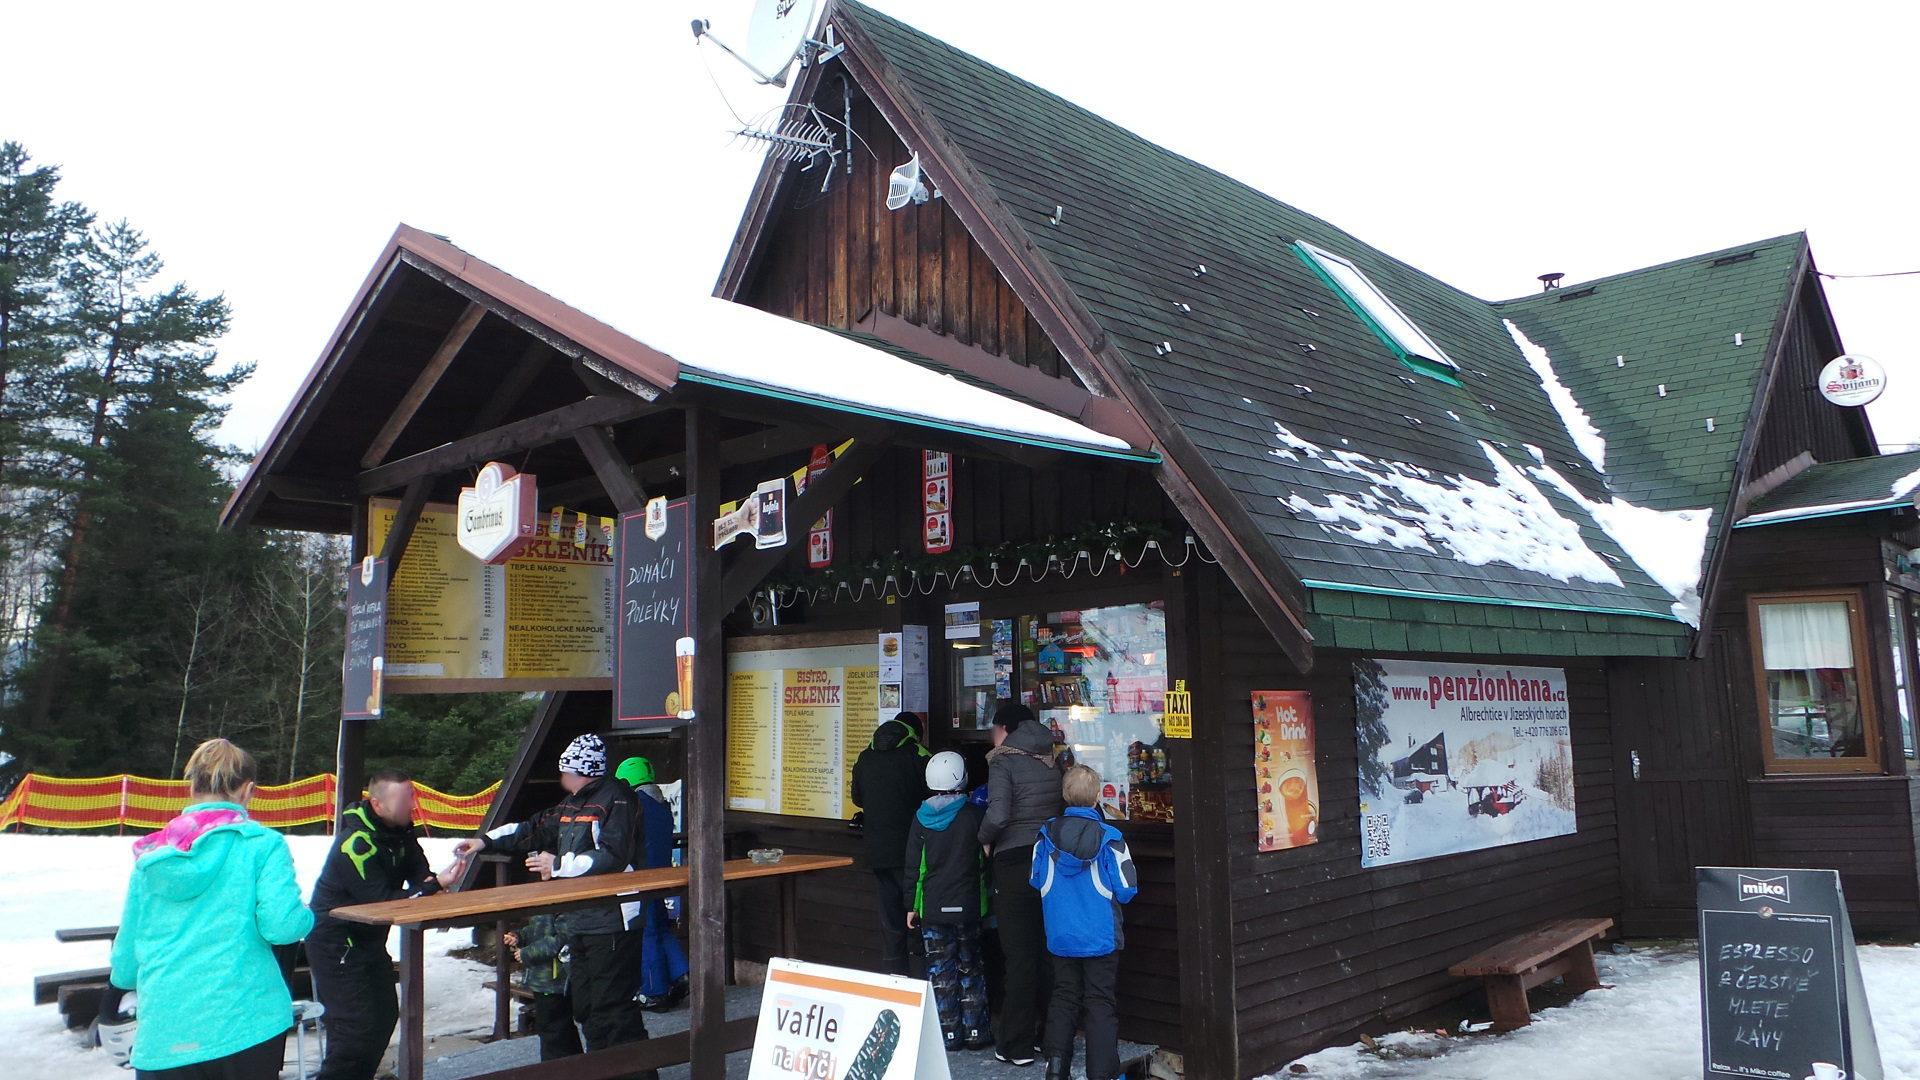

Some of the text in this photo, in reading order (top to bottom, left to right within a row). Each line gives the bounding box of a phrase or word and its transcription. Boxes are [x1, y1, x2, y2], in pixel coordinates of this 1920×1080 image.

[537, 562, 567, 573] NÁPOJE
[509, 624, 605, 634] NEALKOHOLICKÉ NÁPOJE
[784, 680, 841, 705] SKLENÍK
[1392, 669, 1566, 710] www.penzionhana.cz
[1166, 694, 1189, 714] TAXI
[1276, 706, 1298, 723] Hot
[1460, 707, 1503, 722] Albrechtice
[1510, 709, 1544, 724] Jizerských
[1545, 707, 1567, 720] horách
[1281, 723, 1306, 741] Drink
[1743, 883, 1785, 896] miko
[1719, 943, 1814, 964] ESPRESSO
[777, 1004, 838, 1042] vafle
[1712, 1063, 1731, 1071] Relax
[1767, 1070, 1791, 1078] coffee
